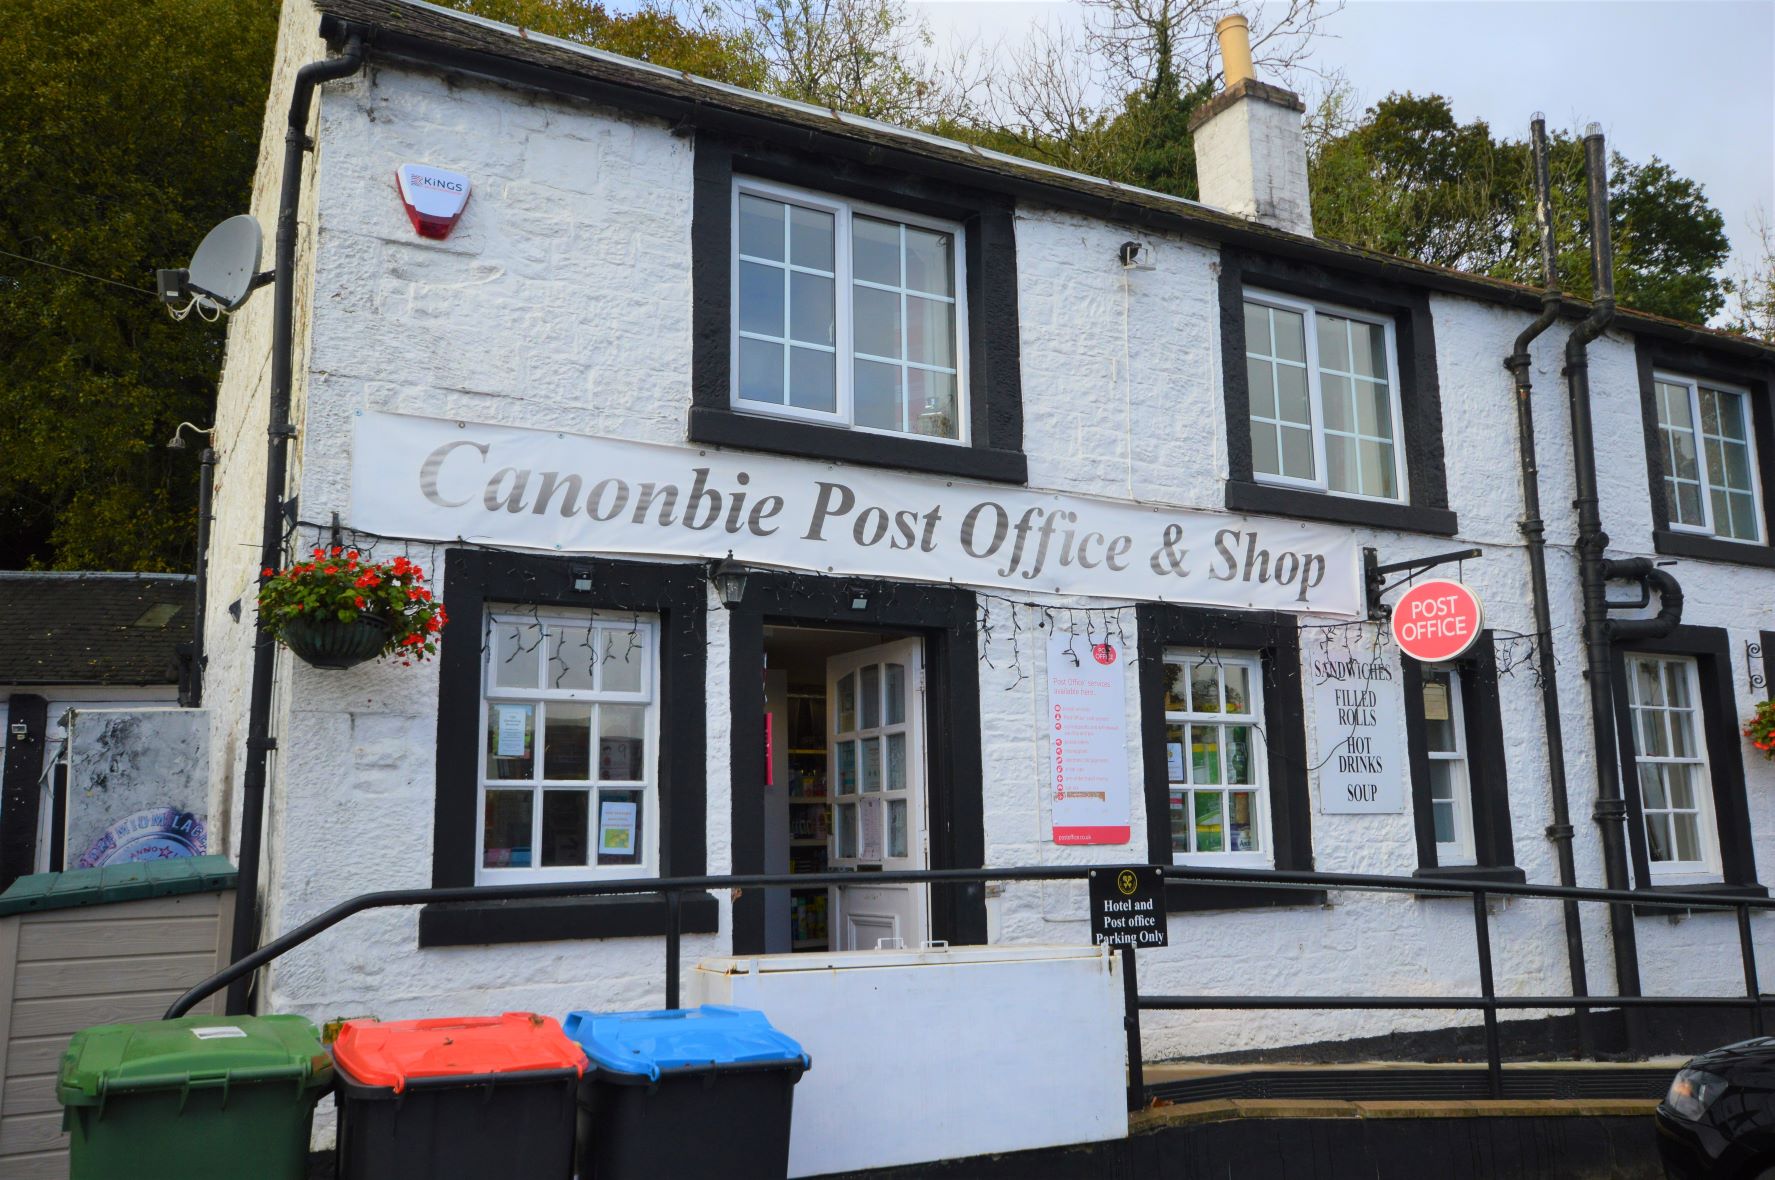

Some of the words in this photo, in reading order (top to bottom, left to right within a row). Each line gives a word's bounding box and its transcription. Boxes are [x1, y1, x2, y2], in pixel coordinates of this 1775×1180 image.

[419, 440, 784, 537] Canonbie
[801, 480, 942, 553] Post
[960, 501, 1132, 580] Office
[1150, 522, 1190, 578] &
[1208, 529, 1326, 602] Shop
[1411, 596, 1458, 619] POST
[1402, 616, 1467, 641] OFFICE
[1314, 660, 1392, 681] SANDWICHES
[1335, 689, 1376, 707] FILLED
[1339, 708, 1377, 726] ROLLS
[1347, 737, 1371, 754] HOT
[1339, 756, 1383, 773] DRINKS
[1347, 784, 1377, 801] SOUP
[1104, 899, 1132, 912] Hotel
[1135, 898, 1153, 911] and
[1104, 916, 1126, 929] Post
[1128, 914, 1156, 927] office
[1096, 932, 1137, 945] Parking
[1140, 930, 1164, 945] Only
